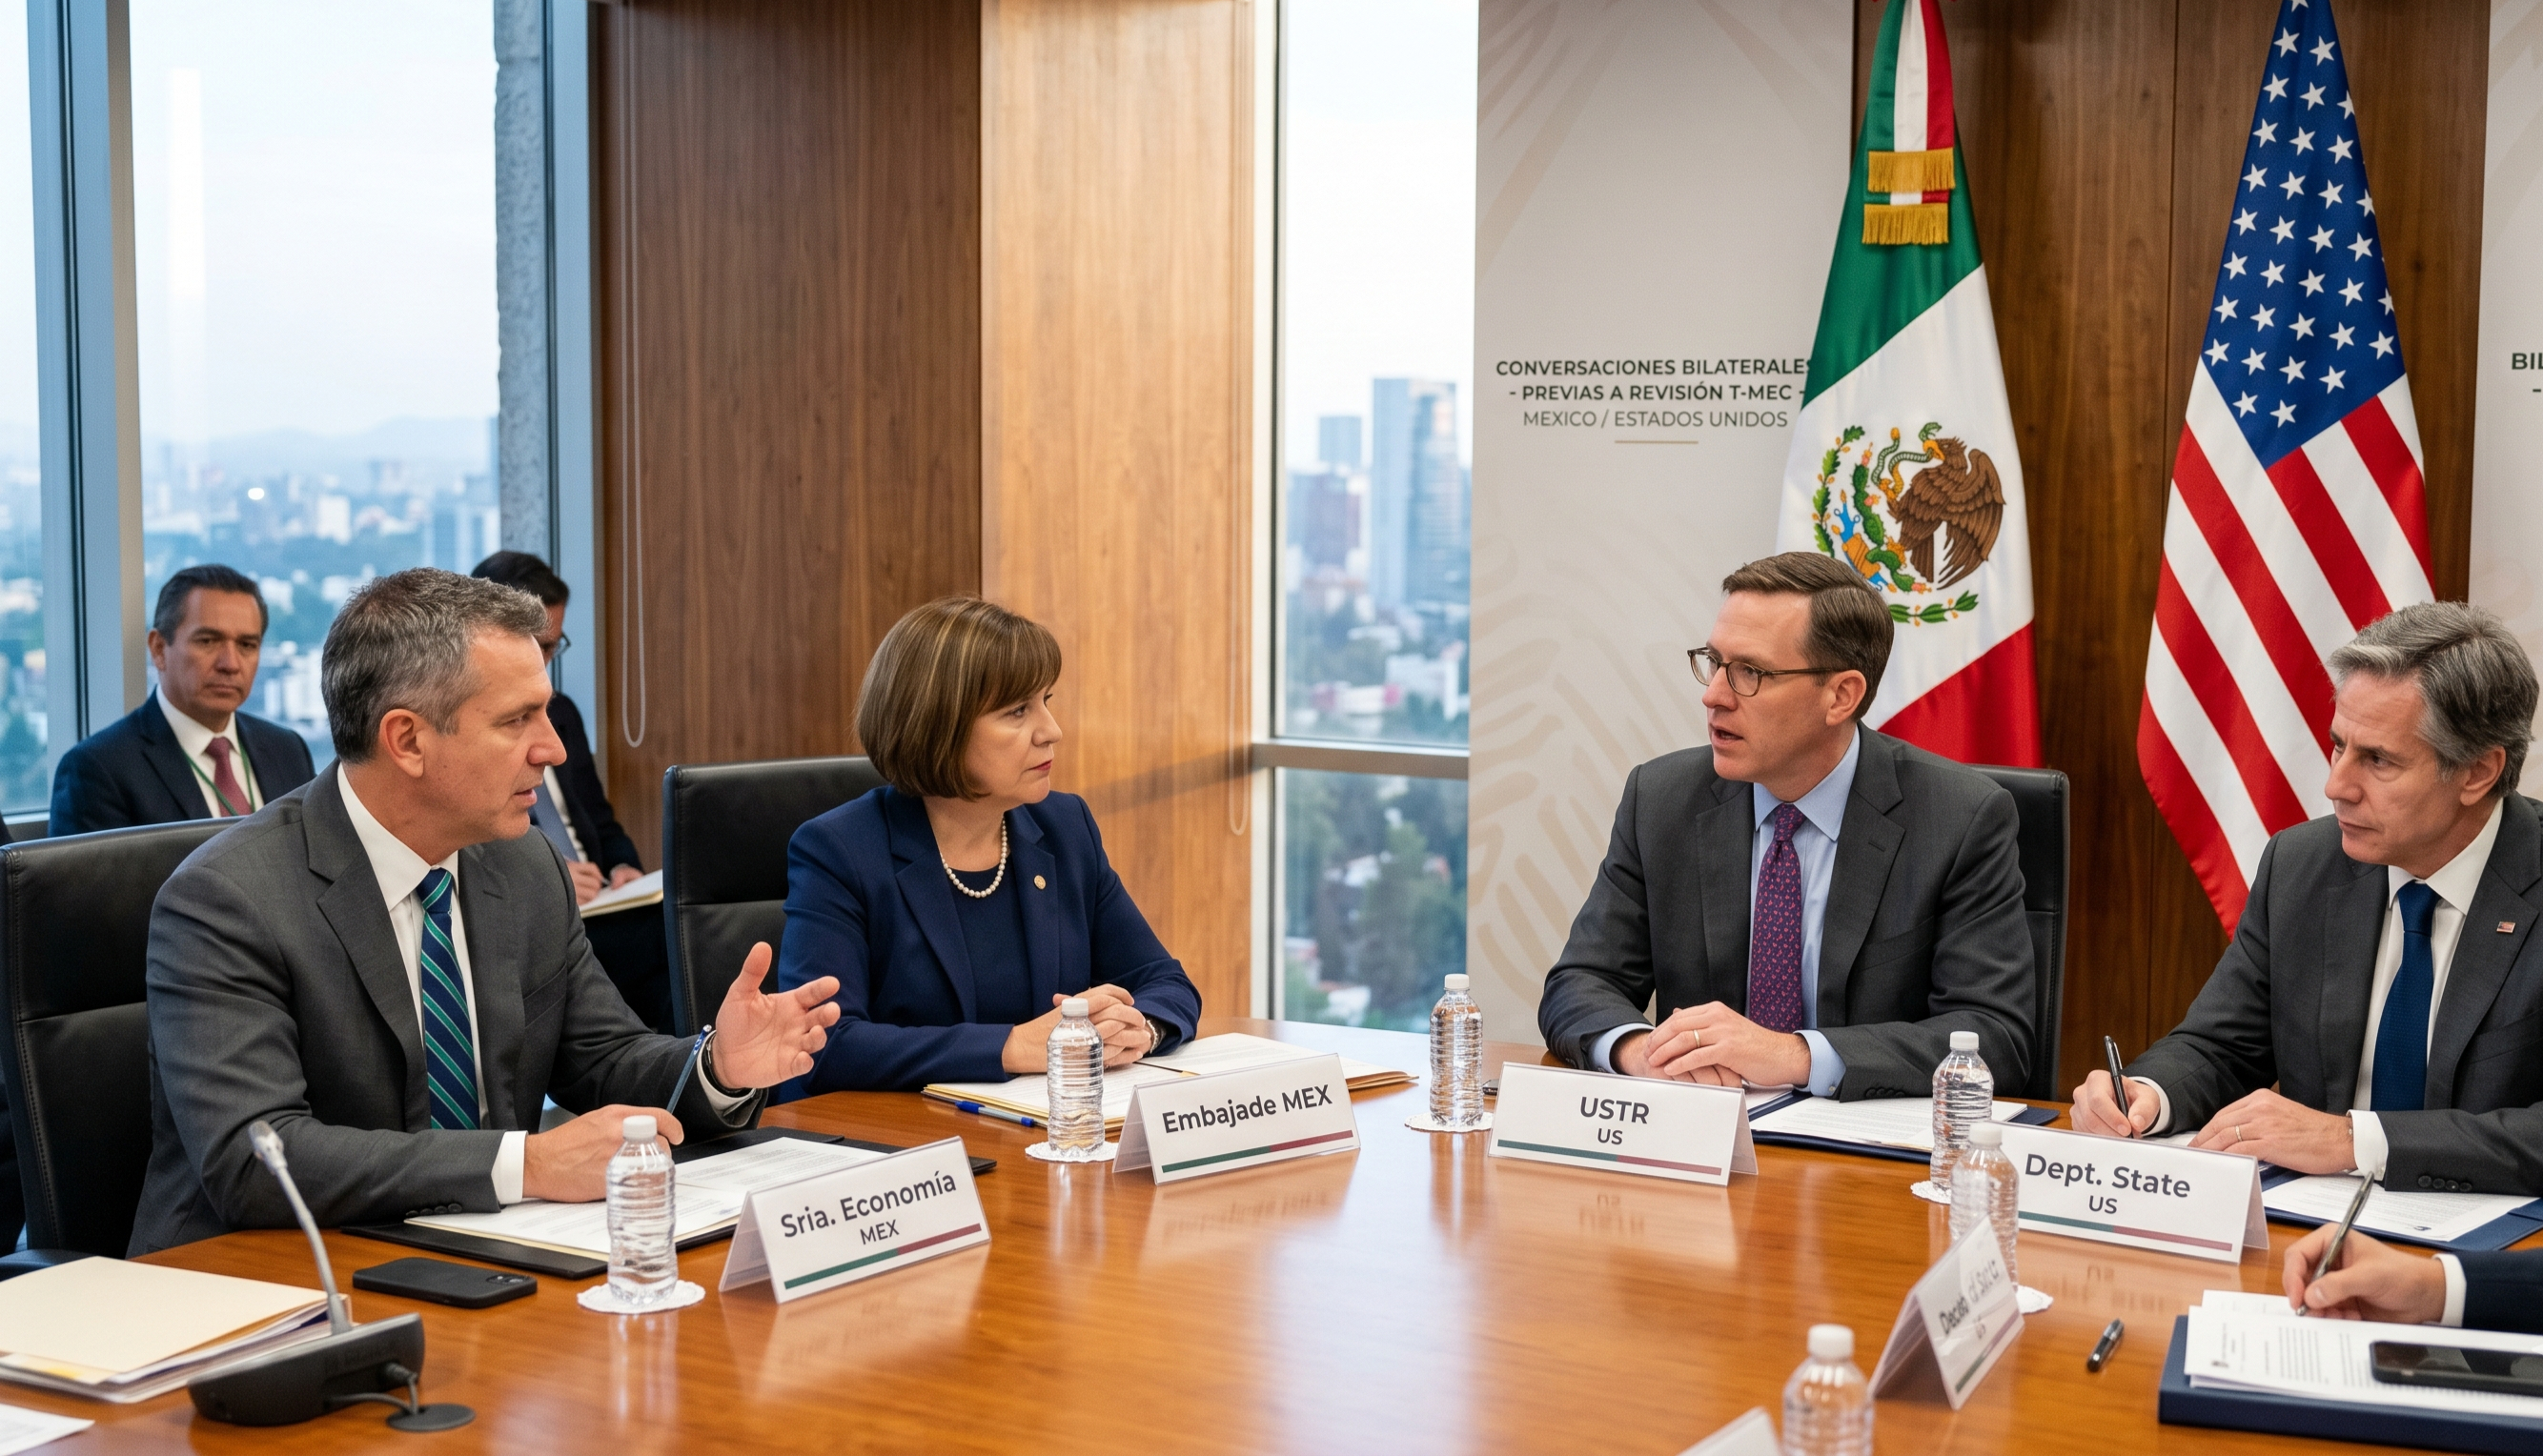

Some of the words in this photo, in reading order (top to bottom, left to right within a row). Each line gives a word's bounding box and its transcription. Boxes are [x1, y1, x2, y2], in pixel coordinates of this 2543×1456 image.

[1496, 360, 1676, 375] CONVERSACIONES
[1522, 386, 1604, 400] PREVIAS
[1609, 386, 1624, 400] A
[1629, 381, 1723, 400] REVISIÓN
[1728, 385, 1792, 400] T-MEC
[1523, 411, 1597, 427] MEXICO
[1600, 409, 1609, 429] /
[1615, 411, 1704, 427] ESTADOS
[1709, 411, 1788, 427] UNIDOS
[1162, 1095, 1277, 1134] Embajade
[1282, 1083, 1333, 1113] MEX
[1580, 1096, 1650, 1124] USTR
[1597, 1127, 1623, 1145] US
[2024, 1153, 2103, 1187] Dept.
[2111, 1165, 2190, 1198] State
[781, 1205, 836, 1238] Sria.
[840, 1170, 957, 1222] Economía
[2088, 1195, 2118, 1215] US
[860, 1219, 900, 1245] MEX
